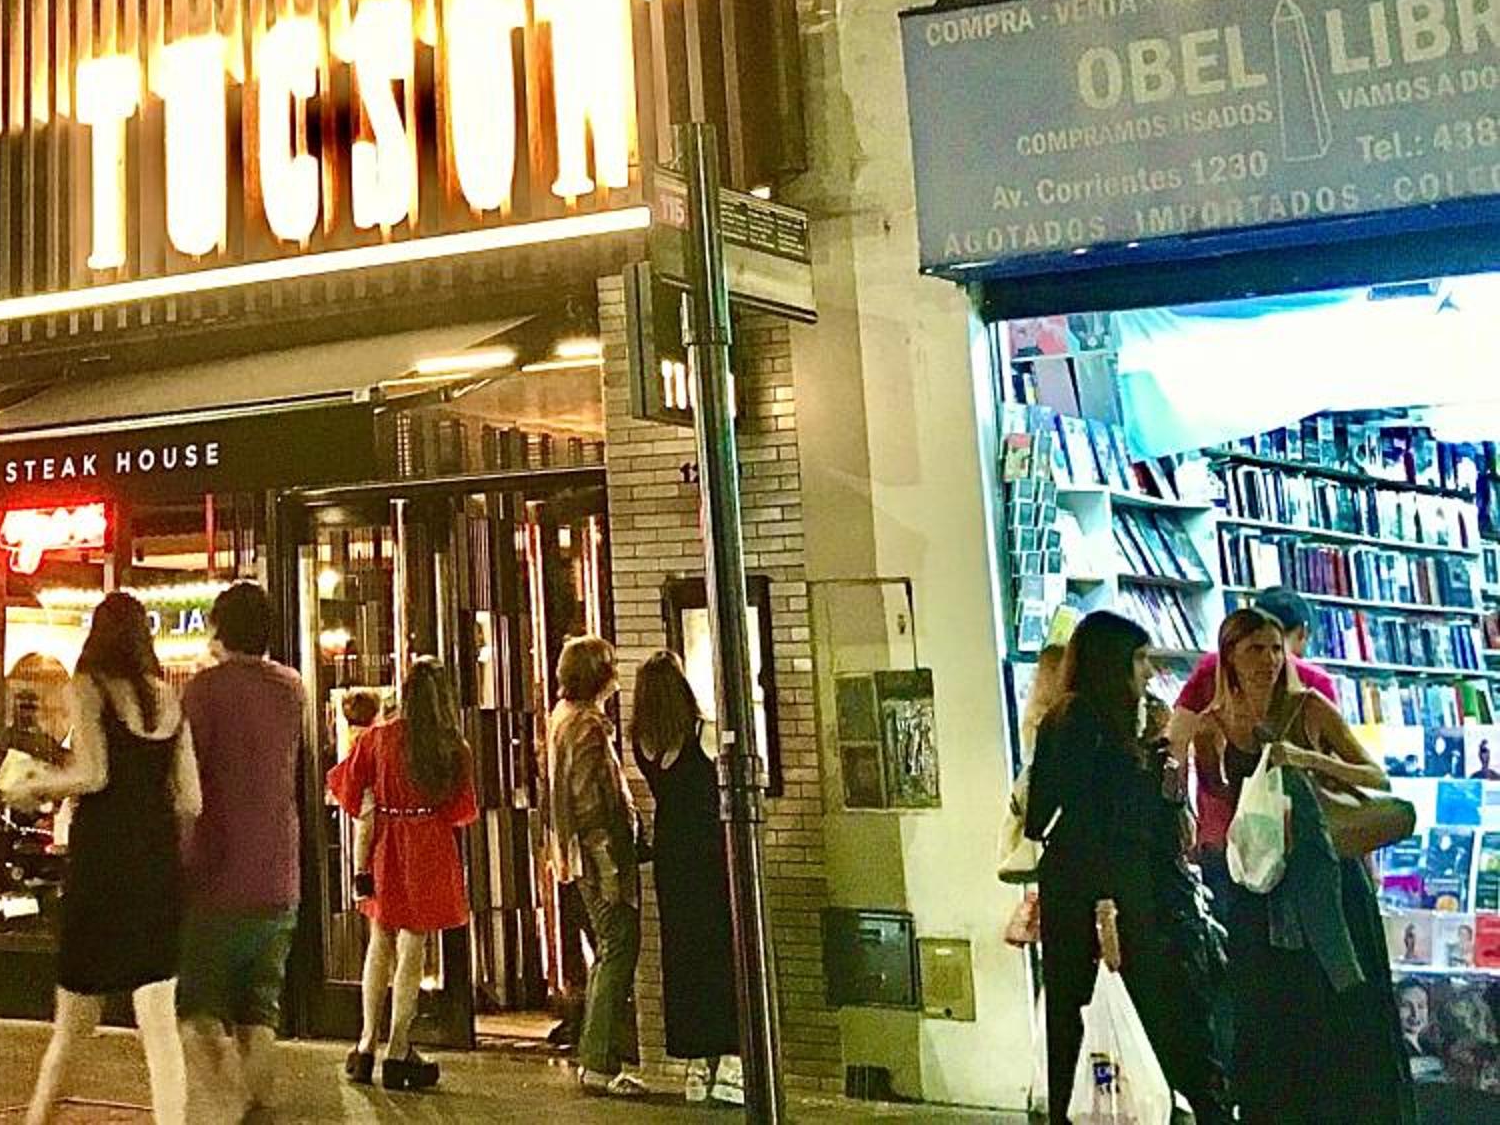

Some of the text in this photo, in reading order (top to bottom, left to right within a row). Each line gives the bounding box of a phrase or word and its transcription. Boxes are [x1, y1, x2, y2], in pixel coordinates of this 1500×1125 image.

[926, 7, 1035, 46] COMPRA
[1077, 26, 1268, 110] OBEL
[1338, 77, 1430, 110] VAMOS
[1437, 72, 1455, 96] A
[1016, 114, 1167, 156] COMPRAMOS
[1356, 115, 1500, 164] Tel.: 438
[993, 150, 1268, 212] Av. Corrientes 1230
[944, 216, 1107, 257] AGOTADOS
[1136, 184, 1359, 236] IMPORTADOS
[5, 443, 219, 483] STEAK HOUSE
